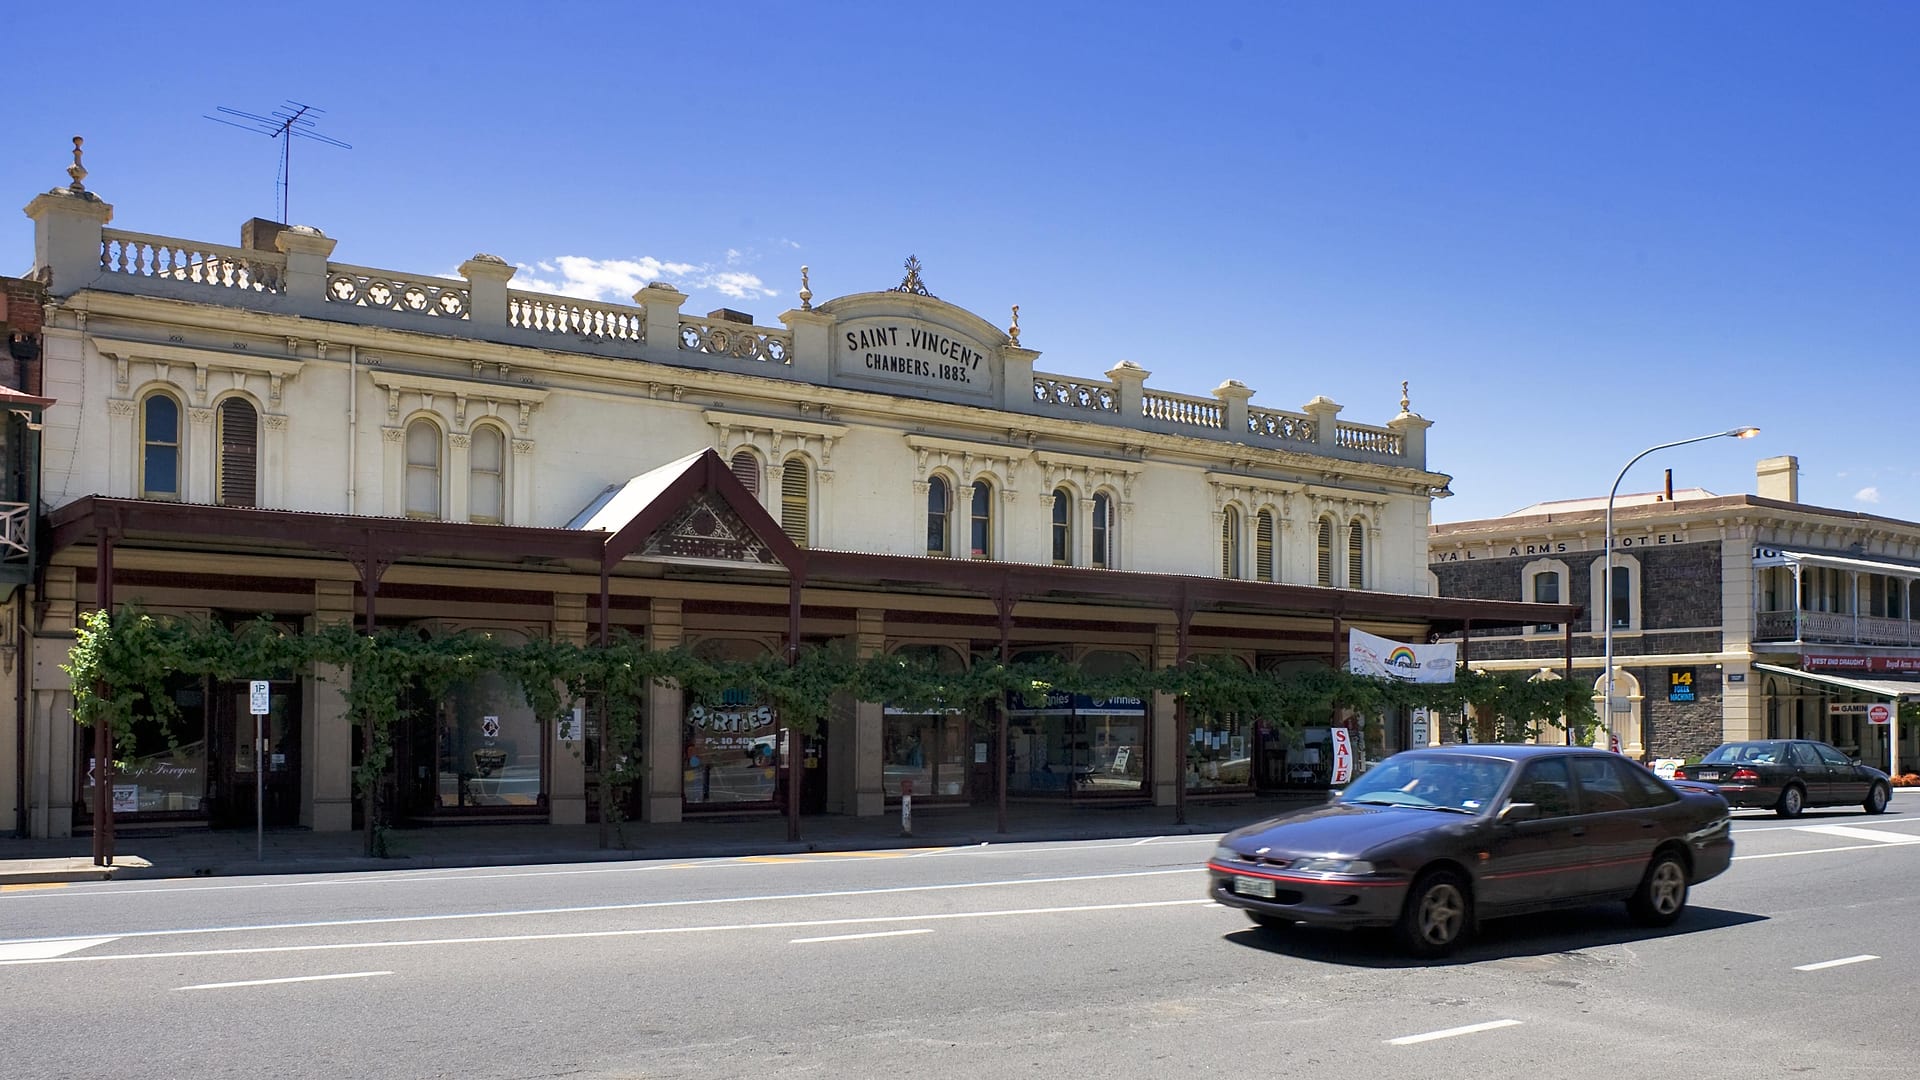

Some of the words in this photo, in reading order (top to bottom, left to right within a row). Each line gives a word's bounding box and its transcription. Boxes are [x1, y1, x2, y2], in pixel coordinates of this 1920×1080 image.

[846, 327, 898, 351] SAINT
[1438, 551, 1476, 562] YAL
[1509, 543, 1567, 556] ARMS
[1811, 657, 1827, 665] WEST
[1827, 658, 1839, 666] END
[1839, 658, 1865, 667] DRAUGHT
[1671, 672, 1693, 685] 14
[255, 684, 266, 693] 1P
[1669, 693, 1695, 701] MACHINES
[1335, 730, 1348, 782] SALE
